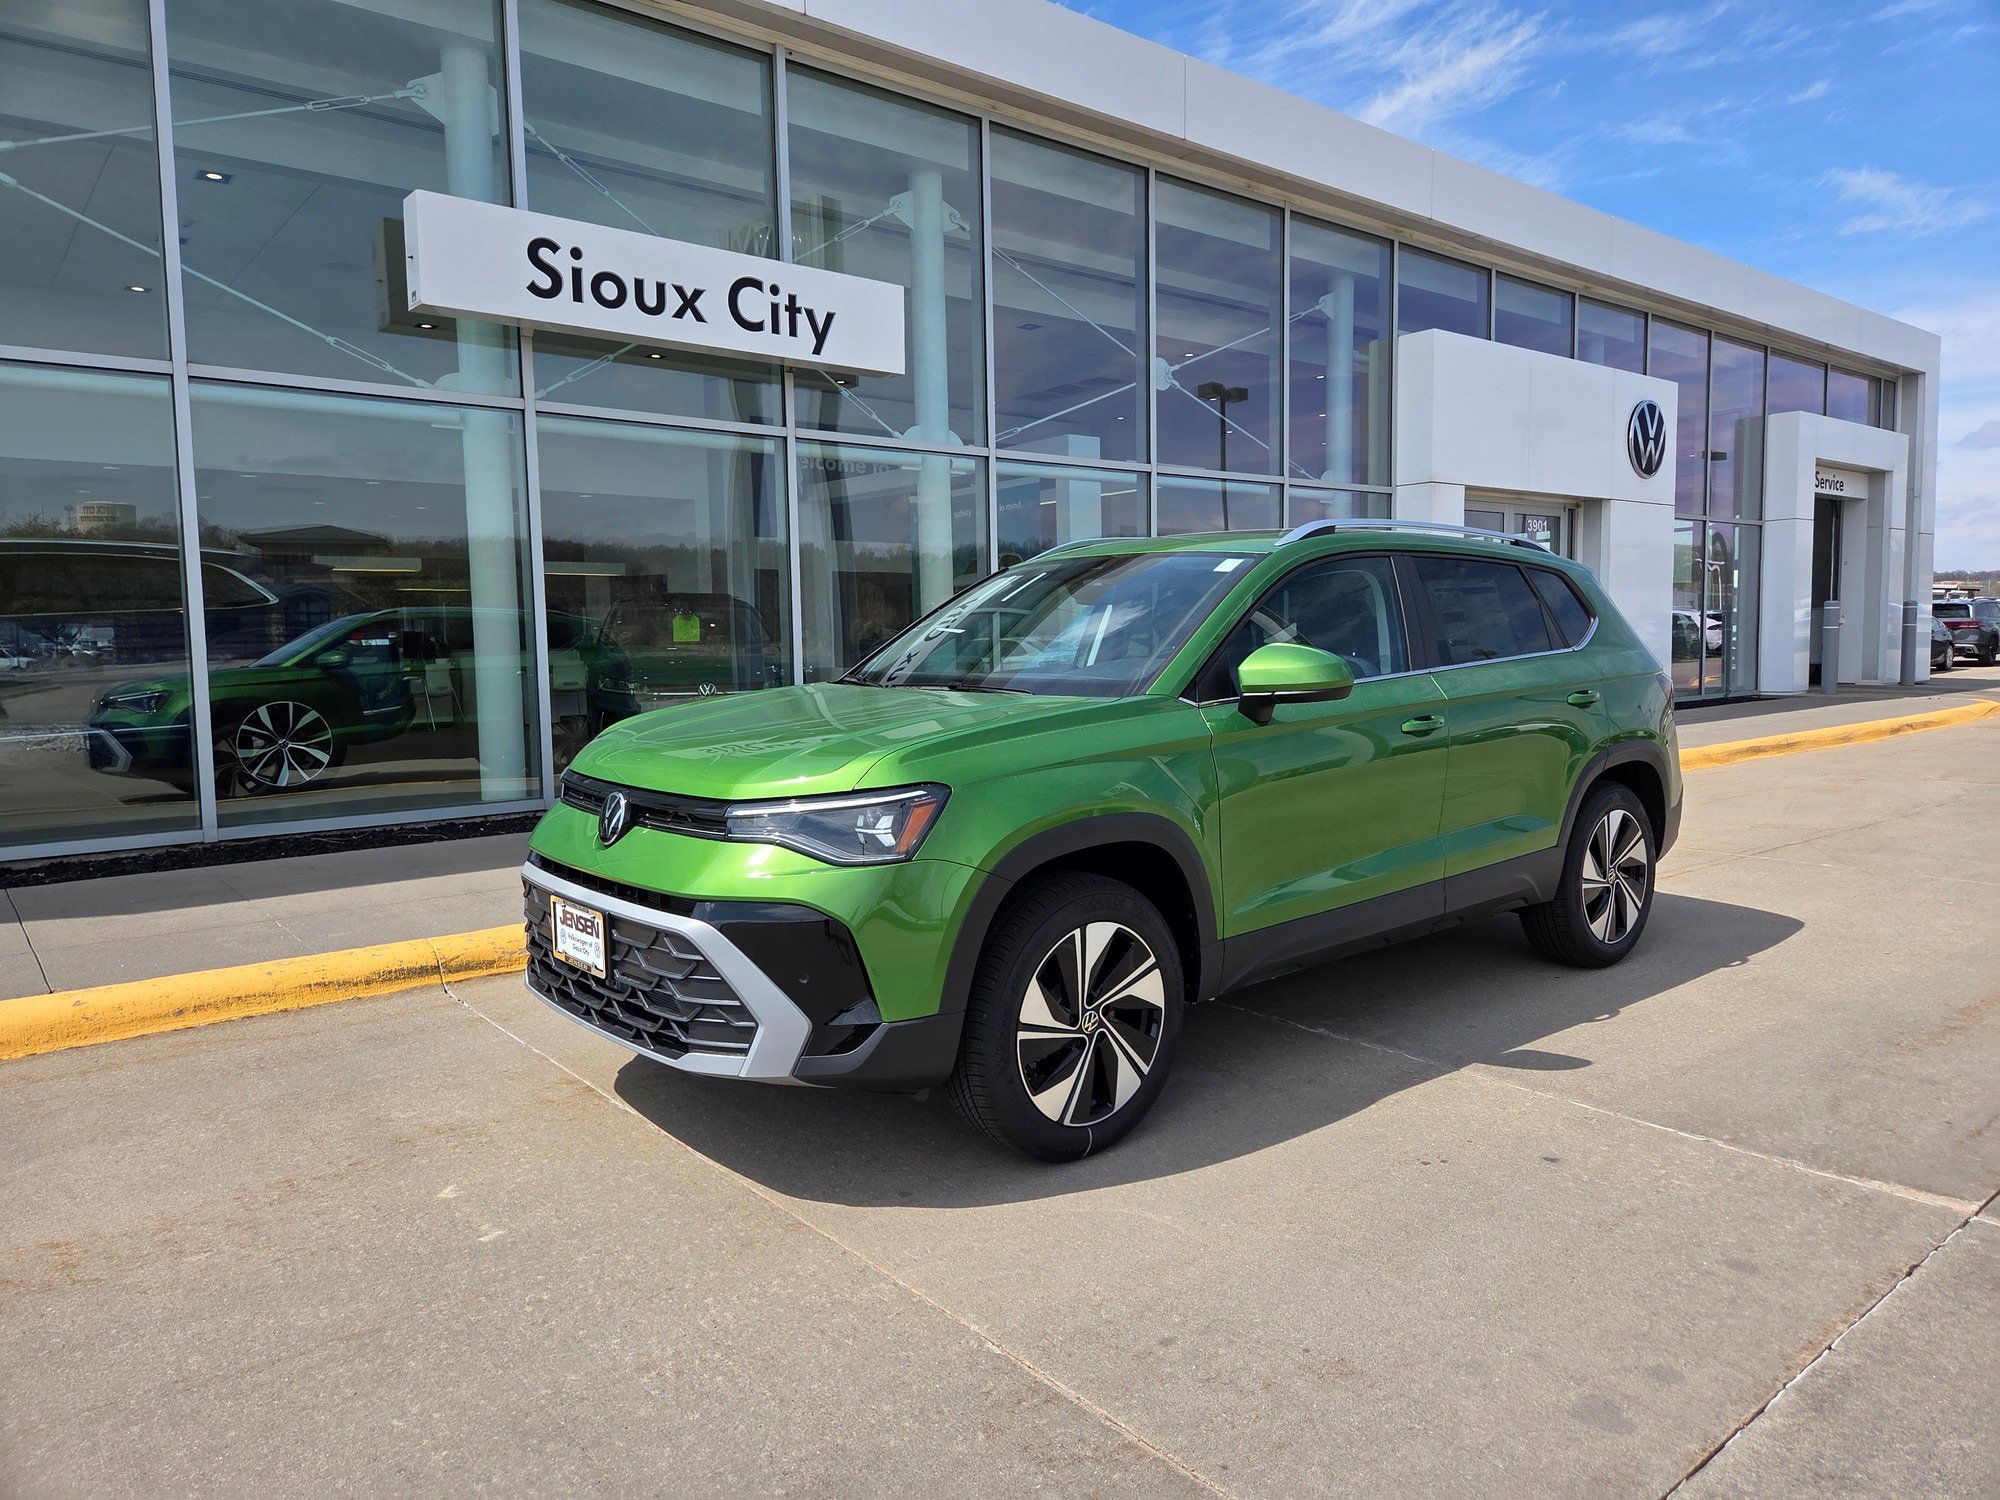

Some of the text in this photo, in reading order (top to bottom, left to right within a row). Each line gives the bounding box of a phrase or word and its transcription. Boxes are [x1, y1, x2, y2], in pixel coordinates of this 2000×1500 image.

[526, 236, 836, 356] Sioux City
[1815, 470, 1844, 491] Service
[1527, 519, 1548, 532] 3901
[560, 908, 600, 939] JENSEN
